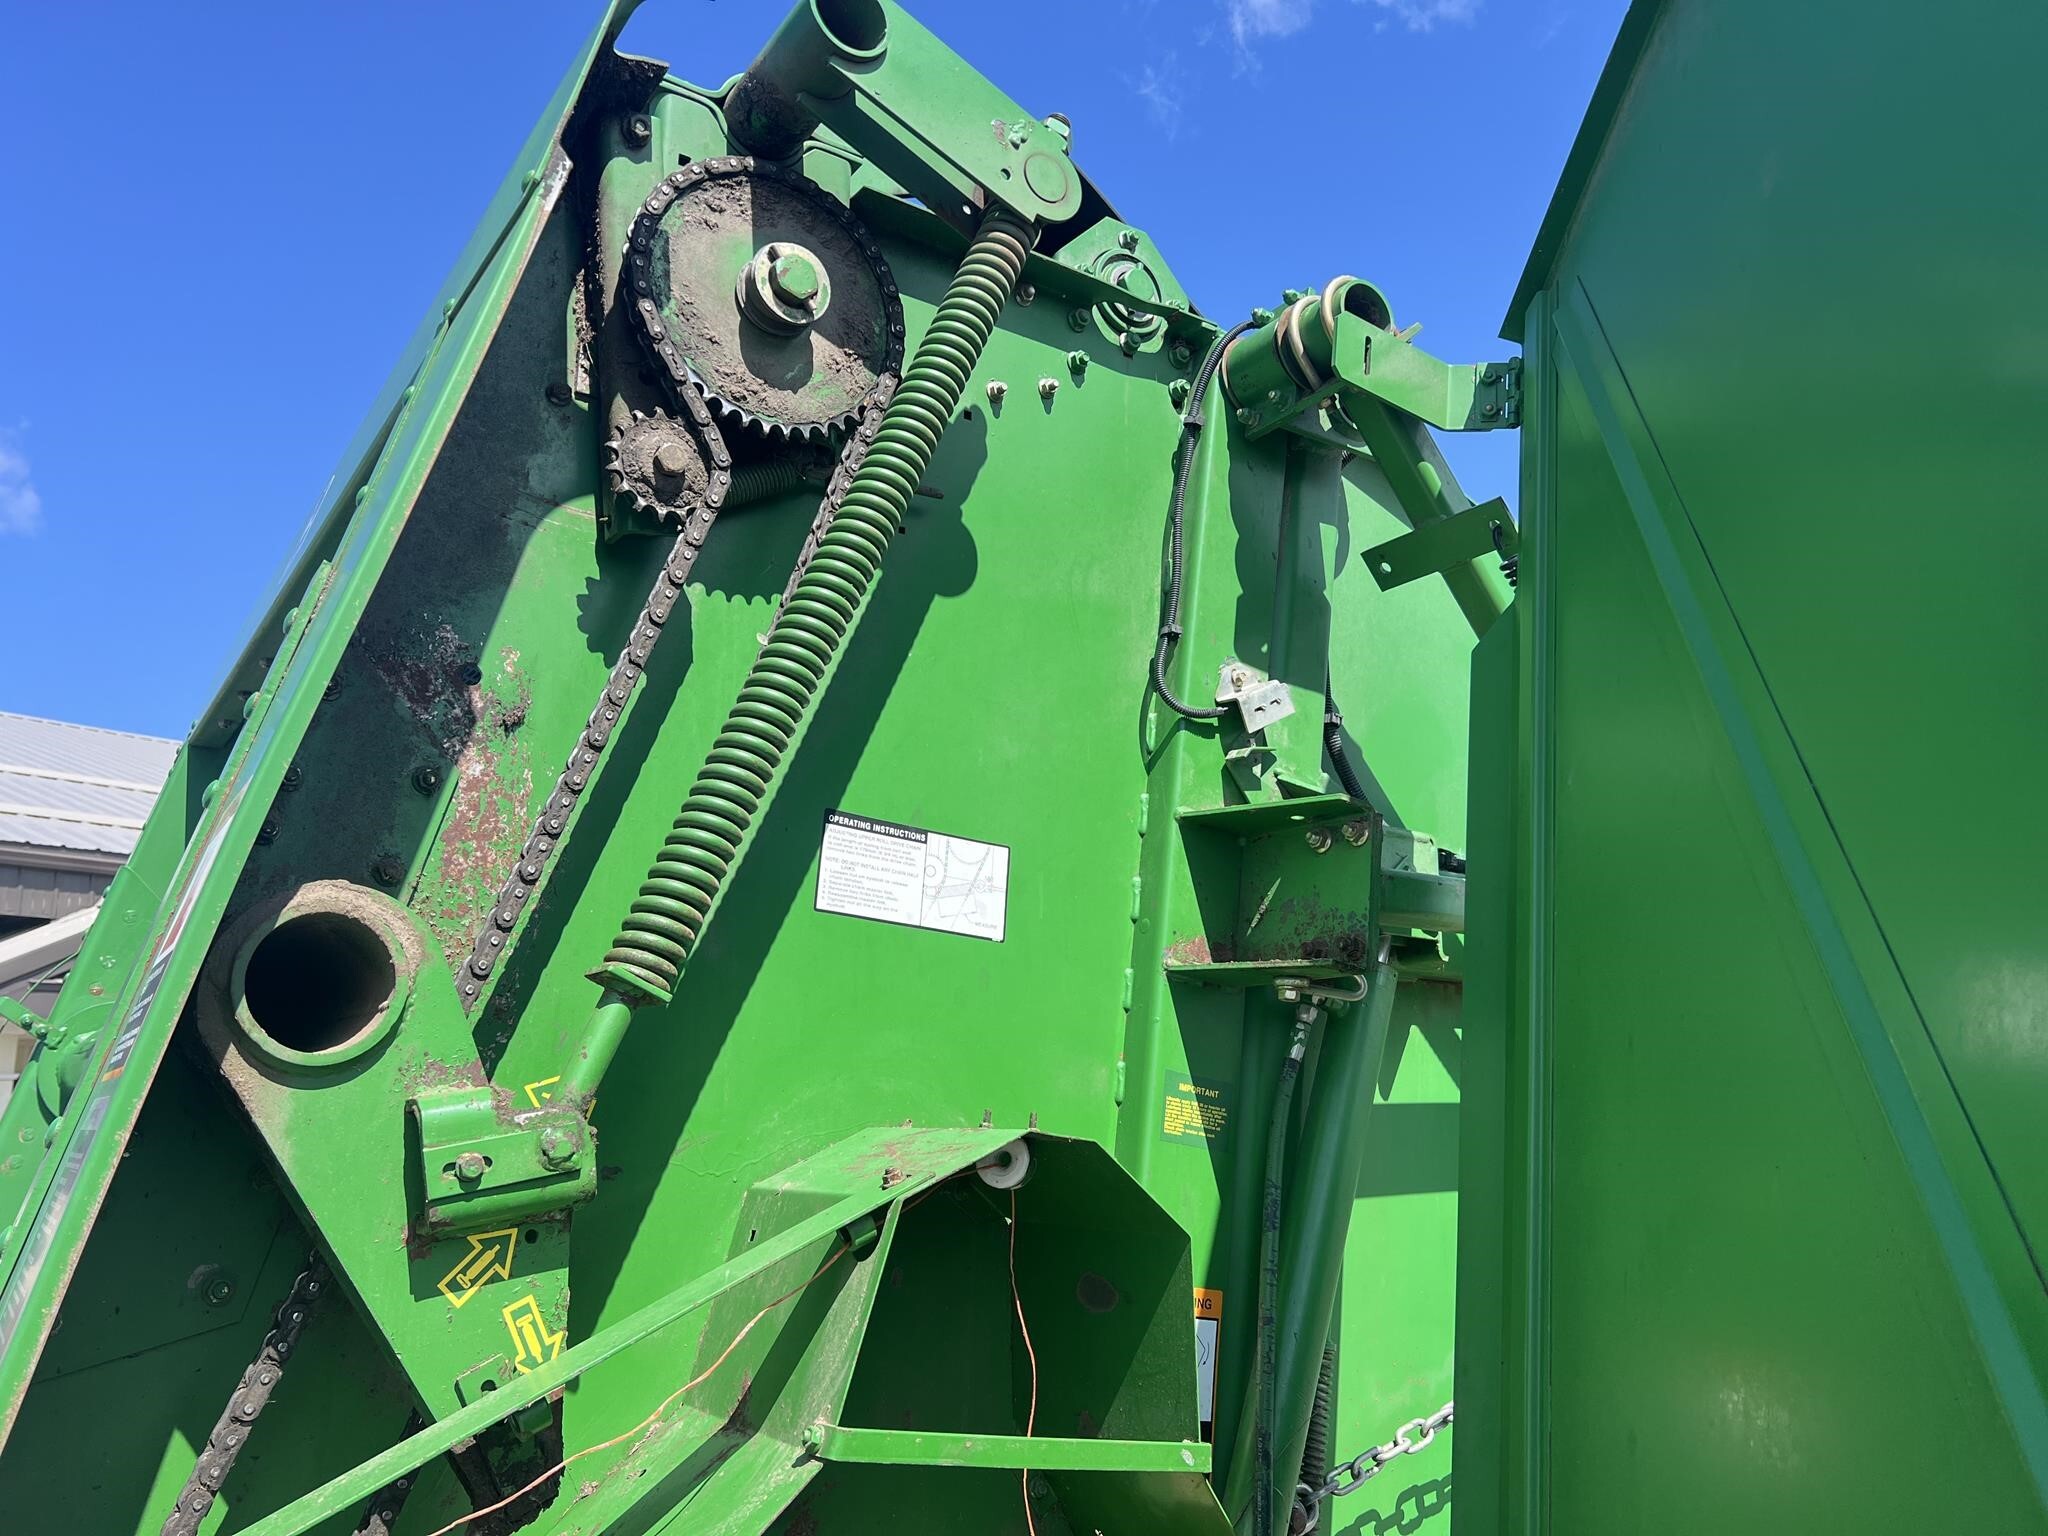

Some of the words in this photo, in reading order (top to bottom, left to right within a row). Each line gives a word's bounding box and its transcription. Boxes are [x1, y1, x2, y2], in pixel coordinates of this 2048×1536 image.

[829, 814, 871, 830] OPERATING
[873, 824, 926, 842] INSTRUCTIONS
[1178, 1082, 1219, 1098] IMPORTANT
